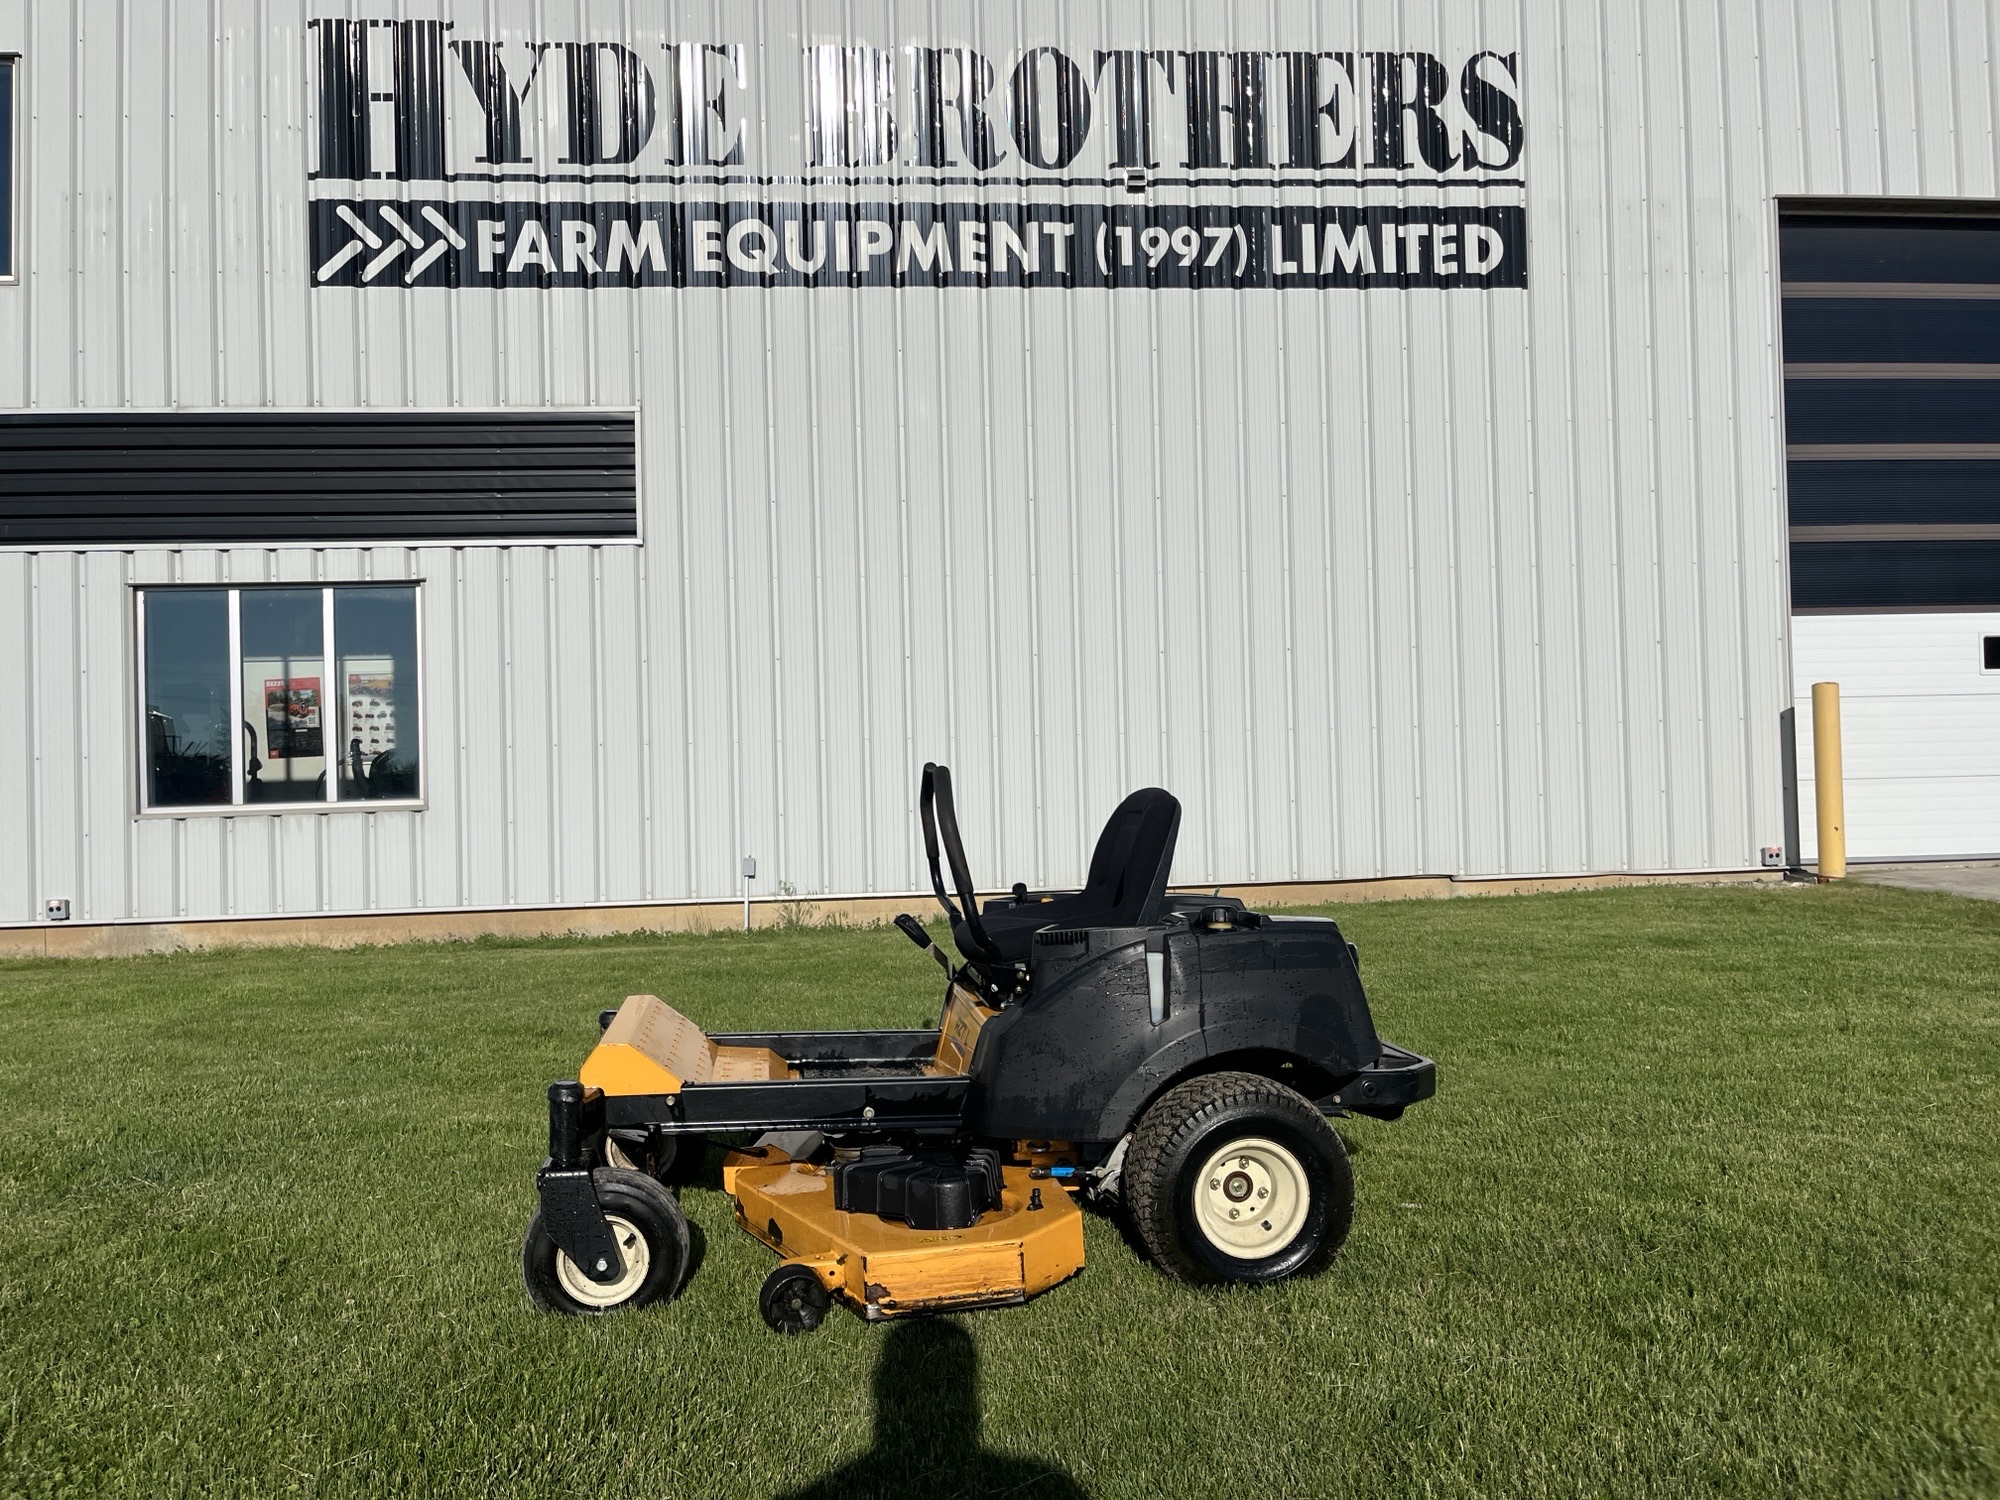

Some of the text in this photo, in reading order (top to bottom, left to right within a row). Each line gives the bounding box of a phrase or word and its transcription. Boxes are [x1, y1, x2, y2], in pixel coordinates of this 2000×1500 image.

[307, 18, 1525, 181] HYDE BROTHERS
[477, 218, 1504, 278] FARM EQUIPMENT (1997) LIMITED
